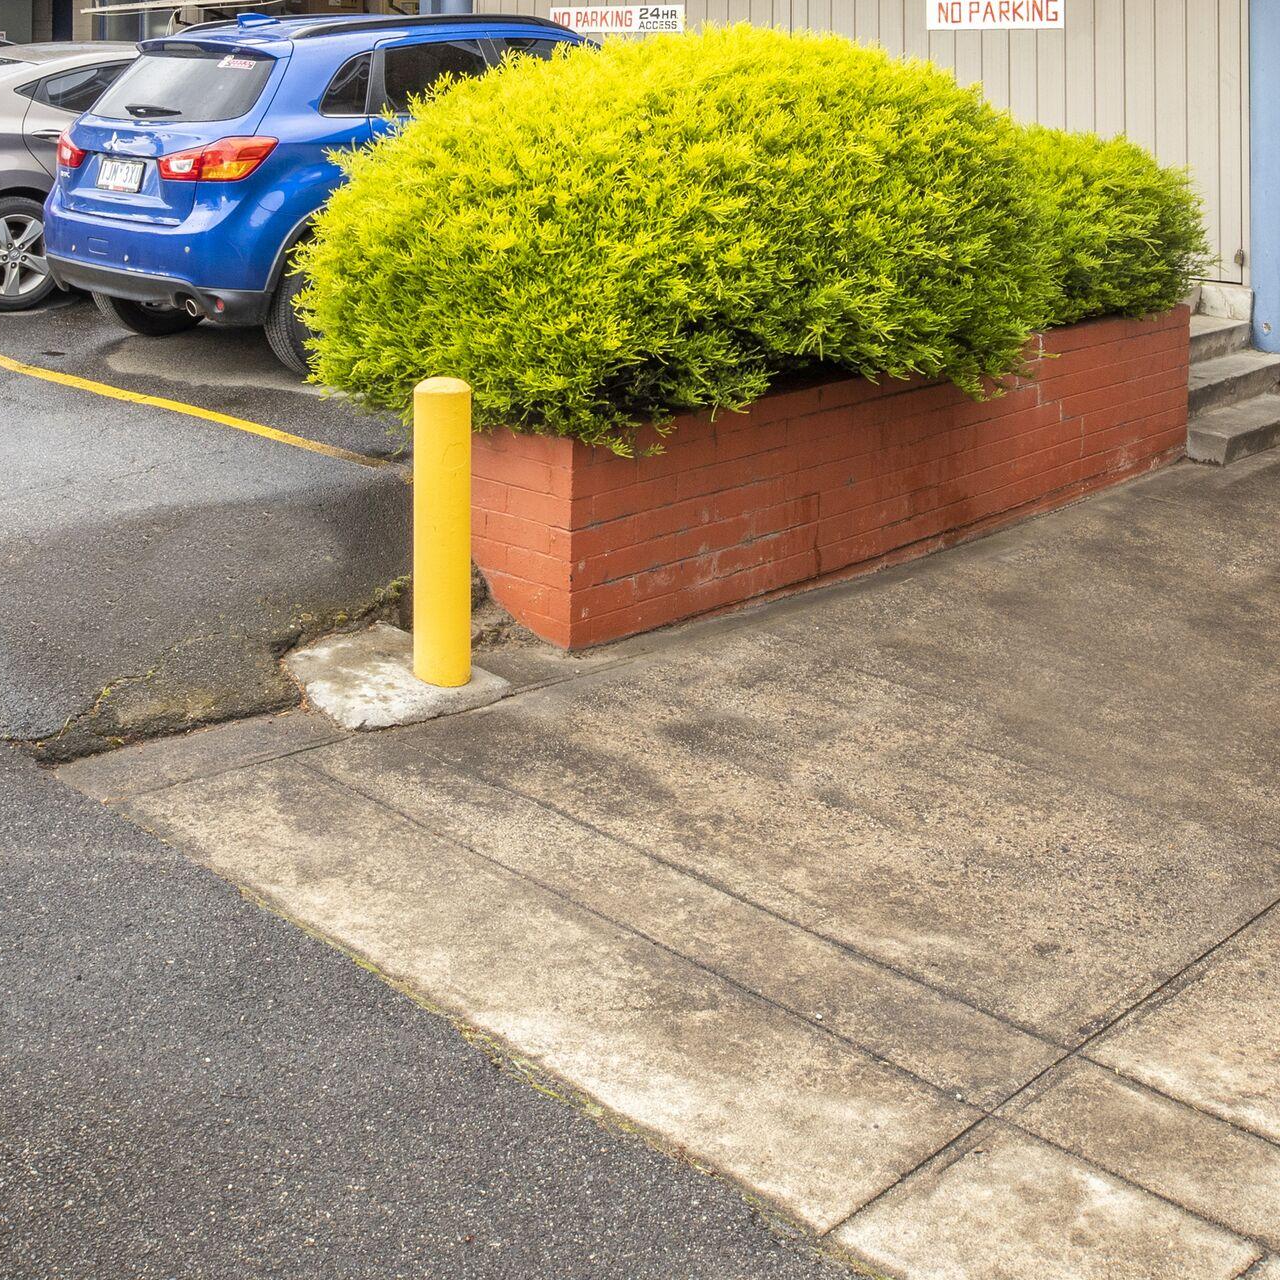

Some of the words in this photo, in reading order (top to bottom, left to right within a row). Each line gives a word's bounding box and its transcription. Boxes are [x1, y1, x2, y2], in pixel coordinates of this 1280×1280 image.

[553, 11, 570, 27] NO
[575, 10, 633, 27] PARKING
[938, 2, 961, 23] NO
[969, 0, 1058, 22] PARKING
[638, 21, 677, 29] ACCESS
